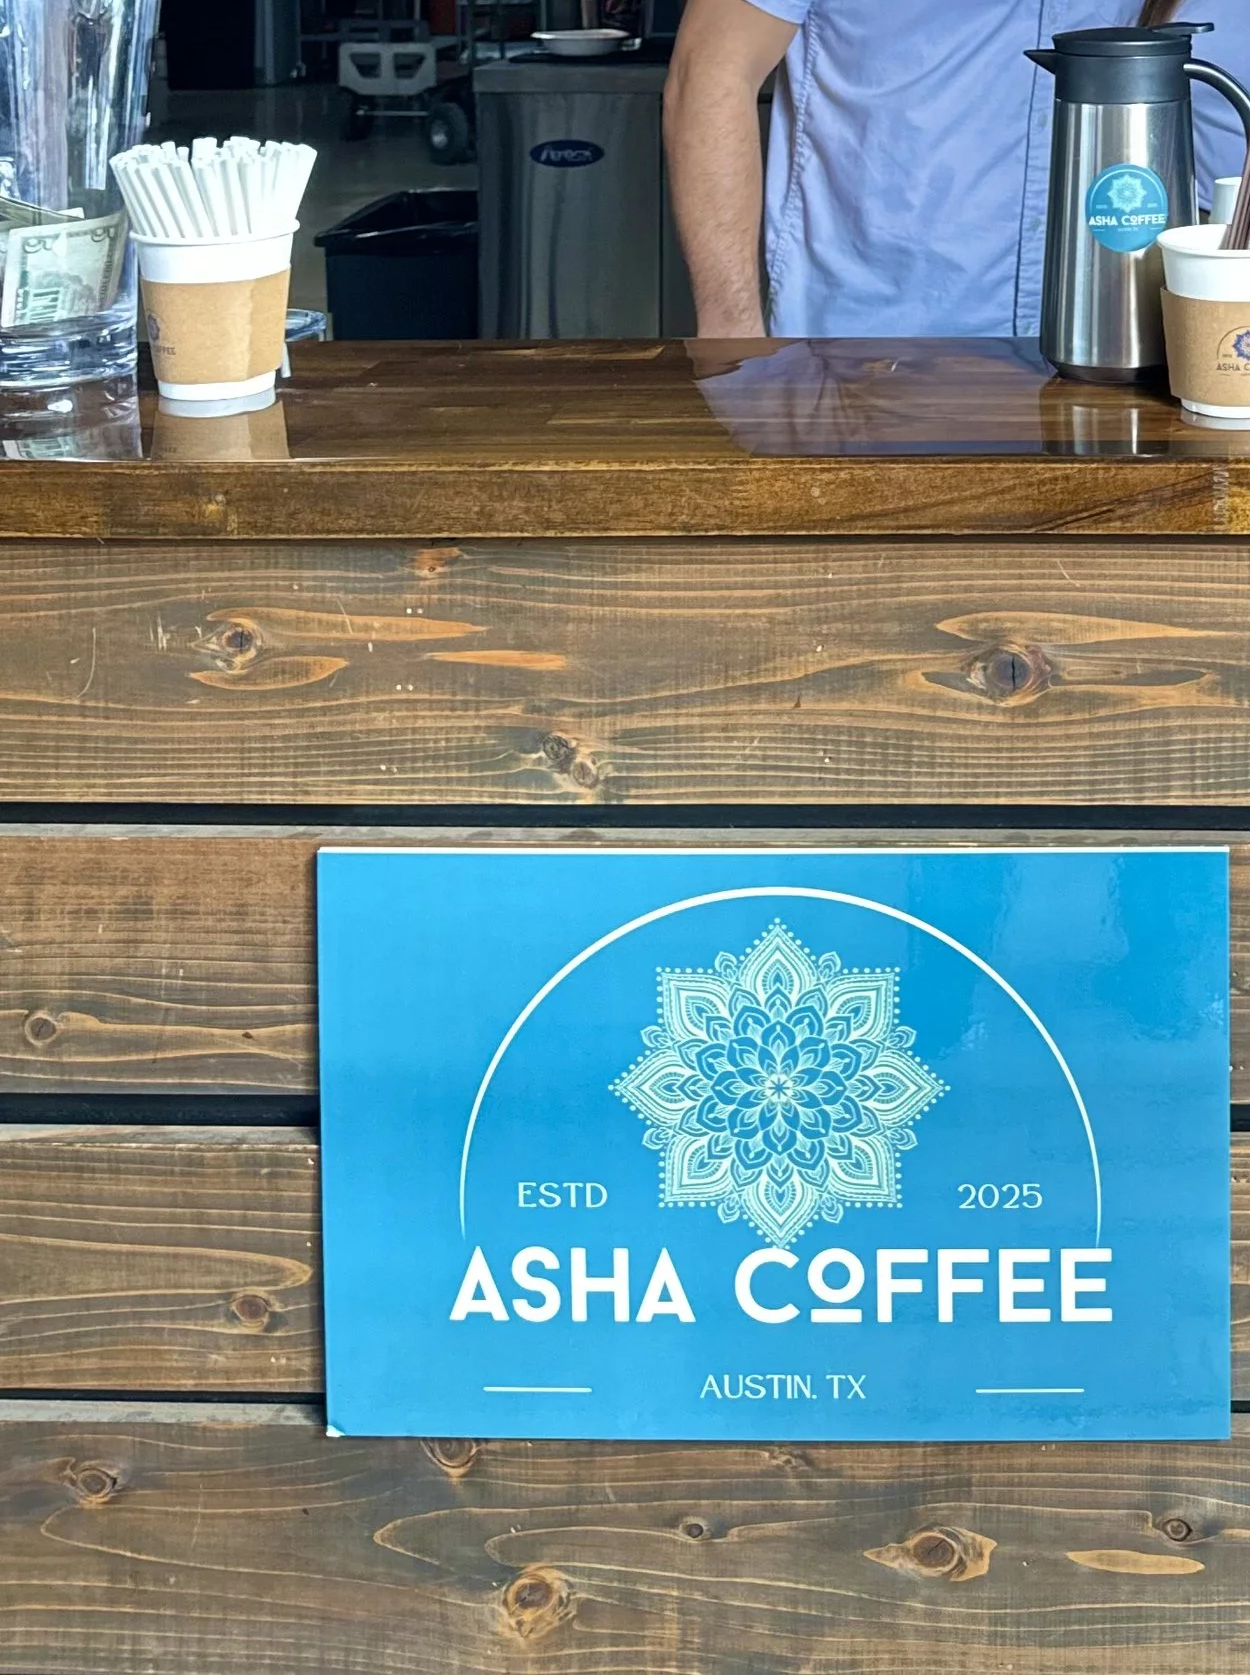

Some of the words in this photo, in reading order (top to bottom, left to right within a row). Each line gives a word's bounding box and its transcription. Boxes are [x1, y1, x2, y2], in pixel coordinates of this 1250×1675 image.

[1088, 215, 1118, 226] ASHA
[1216, 362, 1241, 371] ASHA
[517, 1182, 608, 1209] ESTD
[957, 1183, 1043, 1210] 2025
[449, 1246, 696, 1323] ASHA
[826, 1374, 866, 1399] TX
